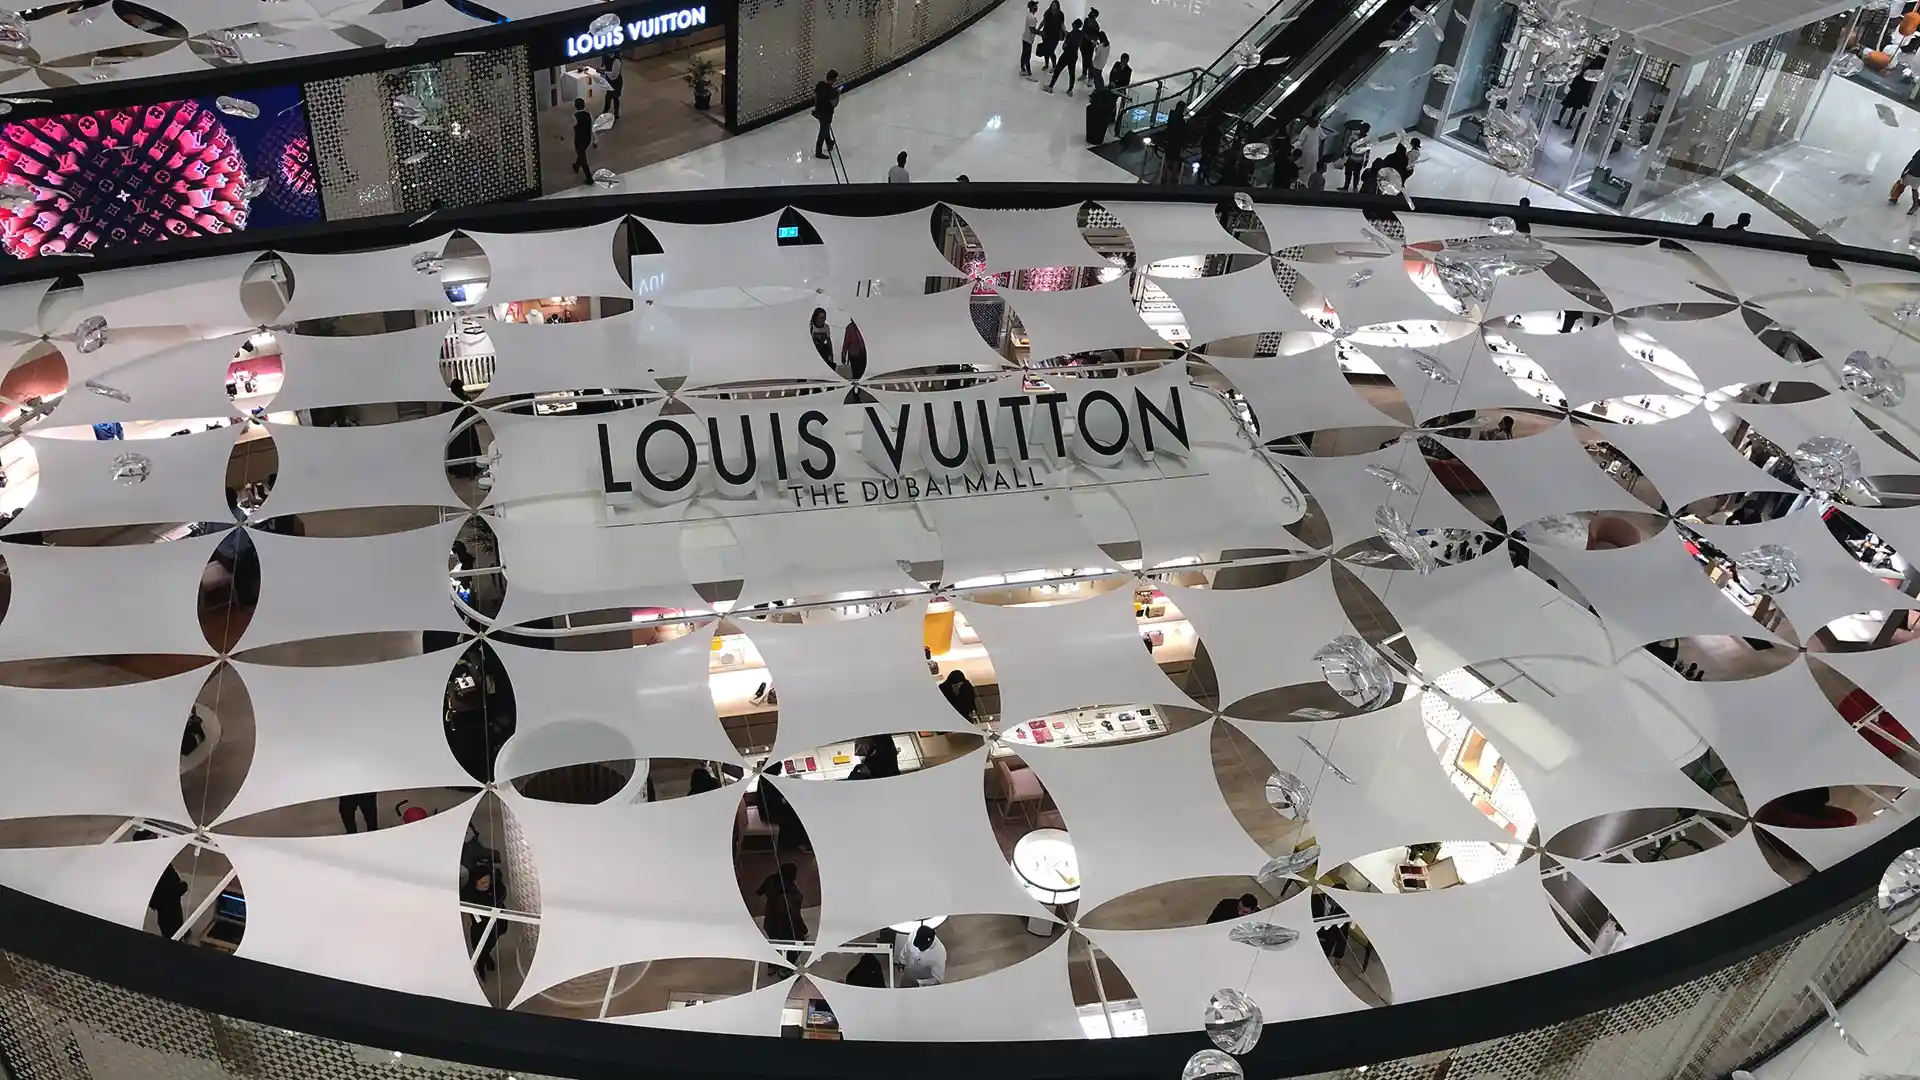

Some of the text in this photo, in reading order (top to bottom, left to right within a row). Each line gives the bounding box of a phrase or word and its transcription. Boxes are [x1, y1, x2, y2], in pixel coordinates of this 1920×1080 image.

[567, 6, 706, 57] LOUIS VUITTON
[121, 147, 138, 167] LV
[72, 205, 95, 224] LV
[131, 197, 150, 215] LV
[597, 386, 1191, 493] LOUIS VUITTON
[787, 466, 1043, 507] THE DUBAI MALL
